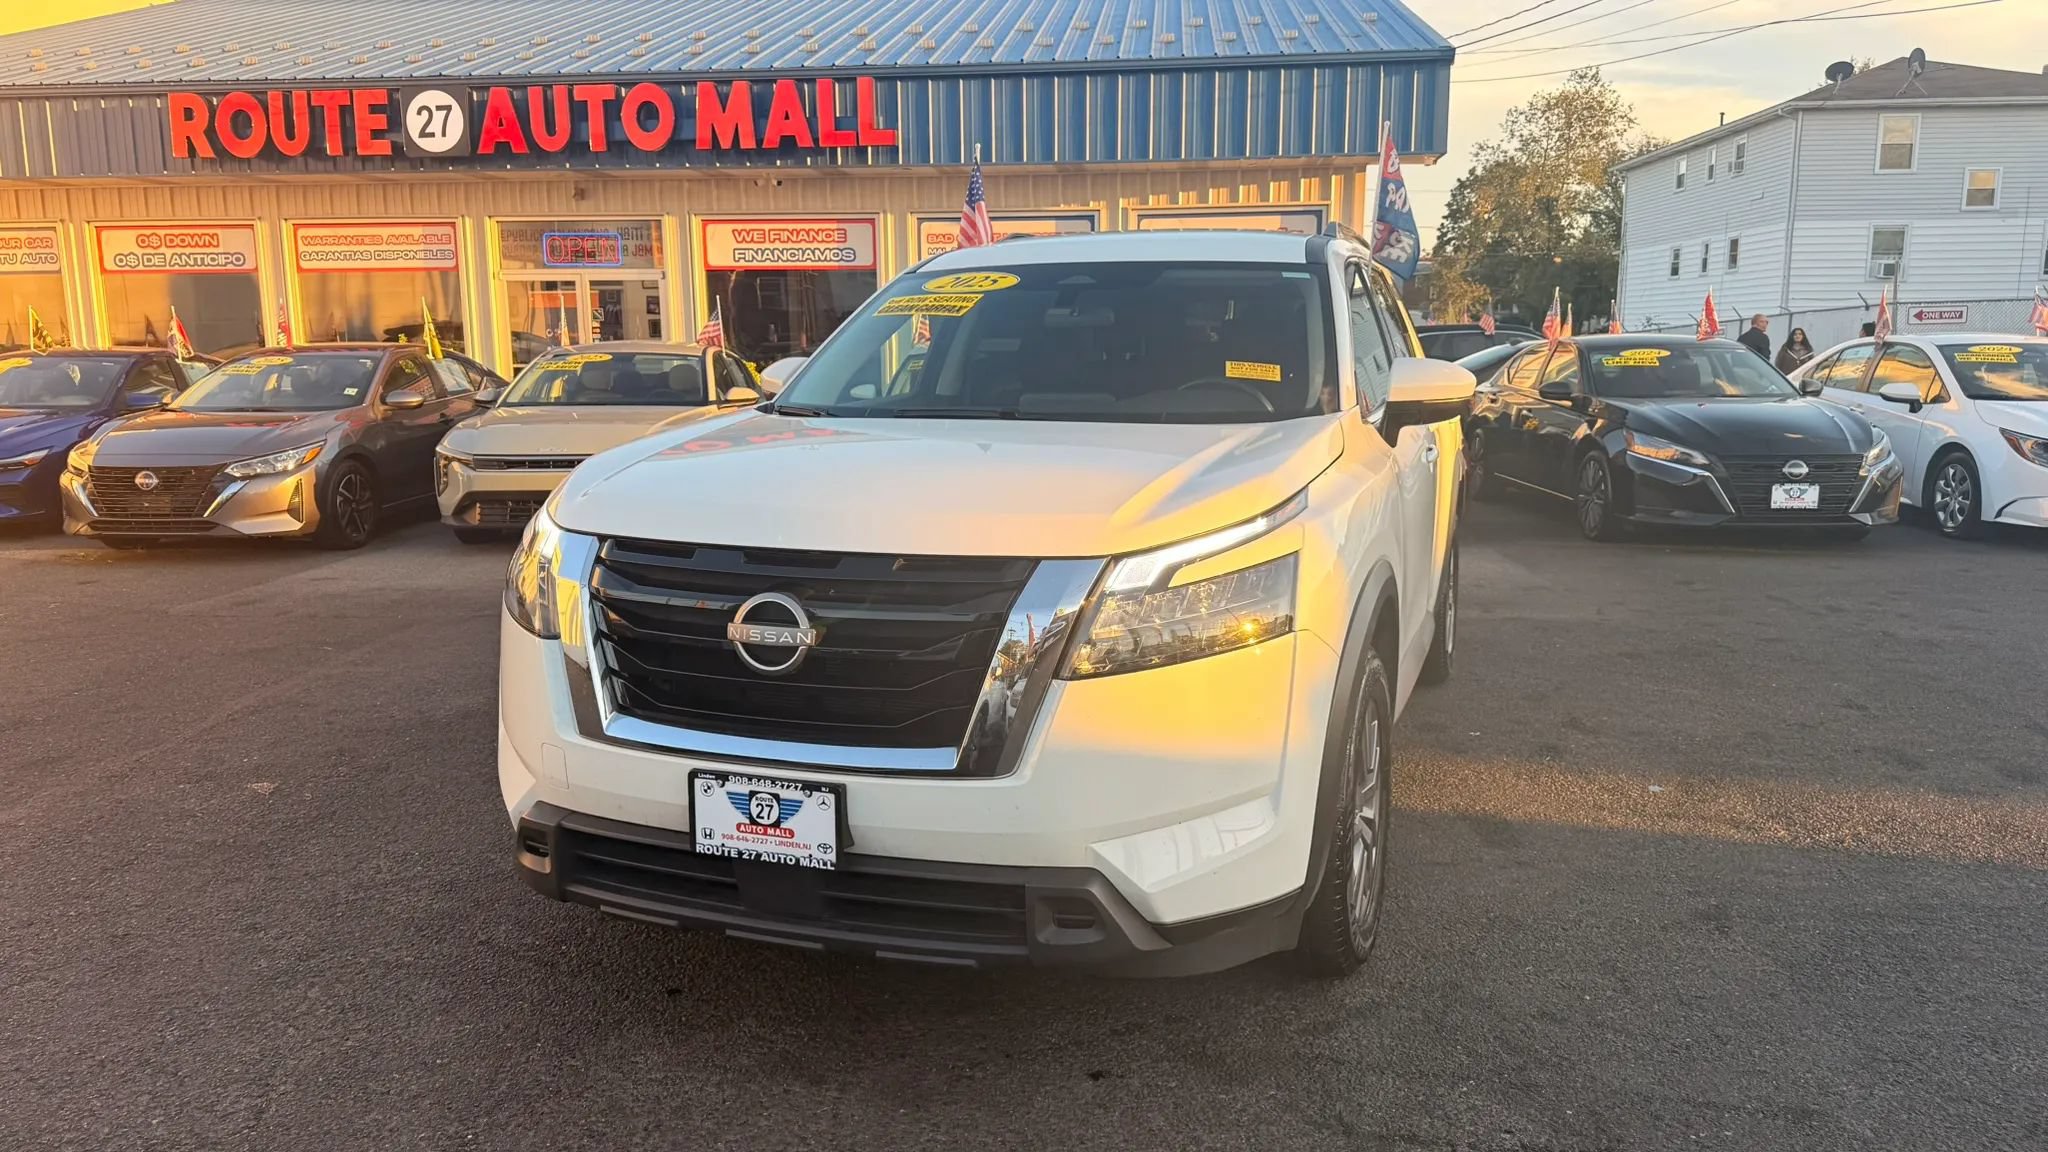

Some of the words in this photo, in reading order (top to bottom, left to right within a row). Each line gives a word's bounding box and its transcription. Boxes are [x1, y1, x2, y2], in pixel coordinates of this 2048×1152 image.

[168, 89, 393, 158] ROUTE
[416, 105, 452, 138] 27
[477, 82, 675, 154] AUTO
[696, 76, 897, 149] MALL
[24, 236, 53, 249] CAR
[164, 233, 219, 248] DOWN
[302, 235, 383, 246] WARRANTIES
[386, 234, 451, 245] AVAILABLE
[732, 229, 766, 243] WE
[769, 228, 847, 243] FINANCE
[926, 233, 955, 244] BAD
[300, 250, 372, 262] GARANTIAS
[374, 249, 454, 261] DISPONIBLES
[546, 236, 620, 263] OPEN
[20, 253, 58, 265] AUTO
[142, 254, 167, 267] DE
[169, 253, 245, 267] ANTICIPO
[733, 247, 855, 267] FINANCIAMOS
[938, 275, 1008, 289] 2025
[929, 295, 979, 304] SEATING
[1922, 311, 1940, 319] ONE
[729, 627, 812, 643] NISSAN
[728, 775, 802, 791] 908-648-2727
[755, 803, 774, 820] 27
[739, 824, 764, 835] AUTO
[767, 826, 792, 838] MALL
[696, 843, 738, 858] ROUTE
[742, 850, 757, 860] 27
[761, 852, 796, 865] AUTO
[800, 856, 835, 870] MALL
